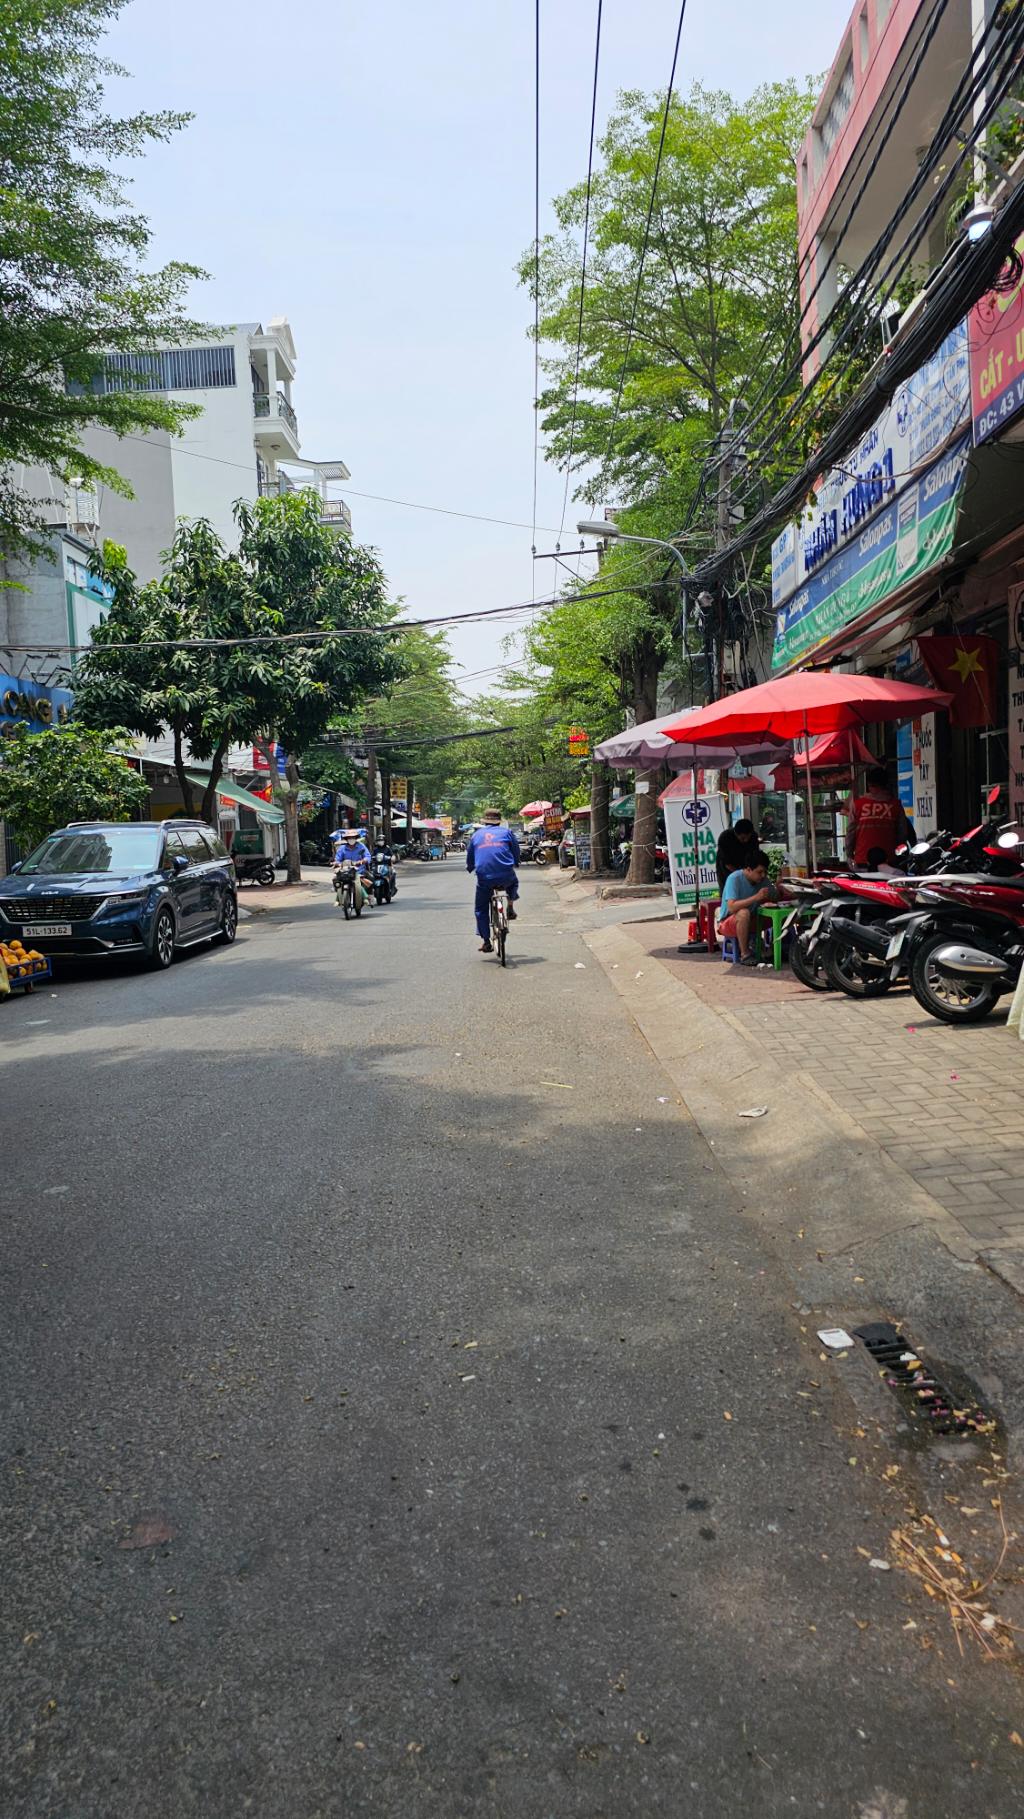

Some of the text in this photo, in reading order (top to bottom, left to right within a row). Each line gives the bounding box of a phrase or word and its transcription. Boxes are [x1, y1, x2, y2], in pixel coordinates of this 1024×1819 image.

[979, 347, 1004, 400] CẮT
[979, 410, 998, 438] ĐC:
[999, 390, 1015, 416] 43
[1012, 691, 1024, 708] TH
[860, 803, 894, 817] SPX
[682, 826, 715, 848] NHÀ
[675, 842, 717, 868] THUỐ
[26, 926, 68, 936] 51L-133.62
